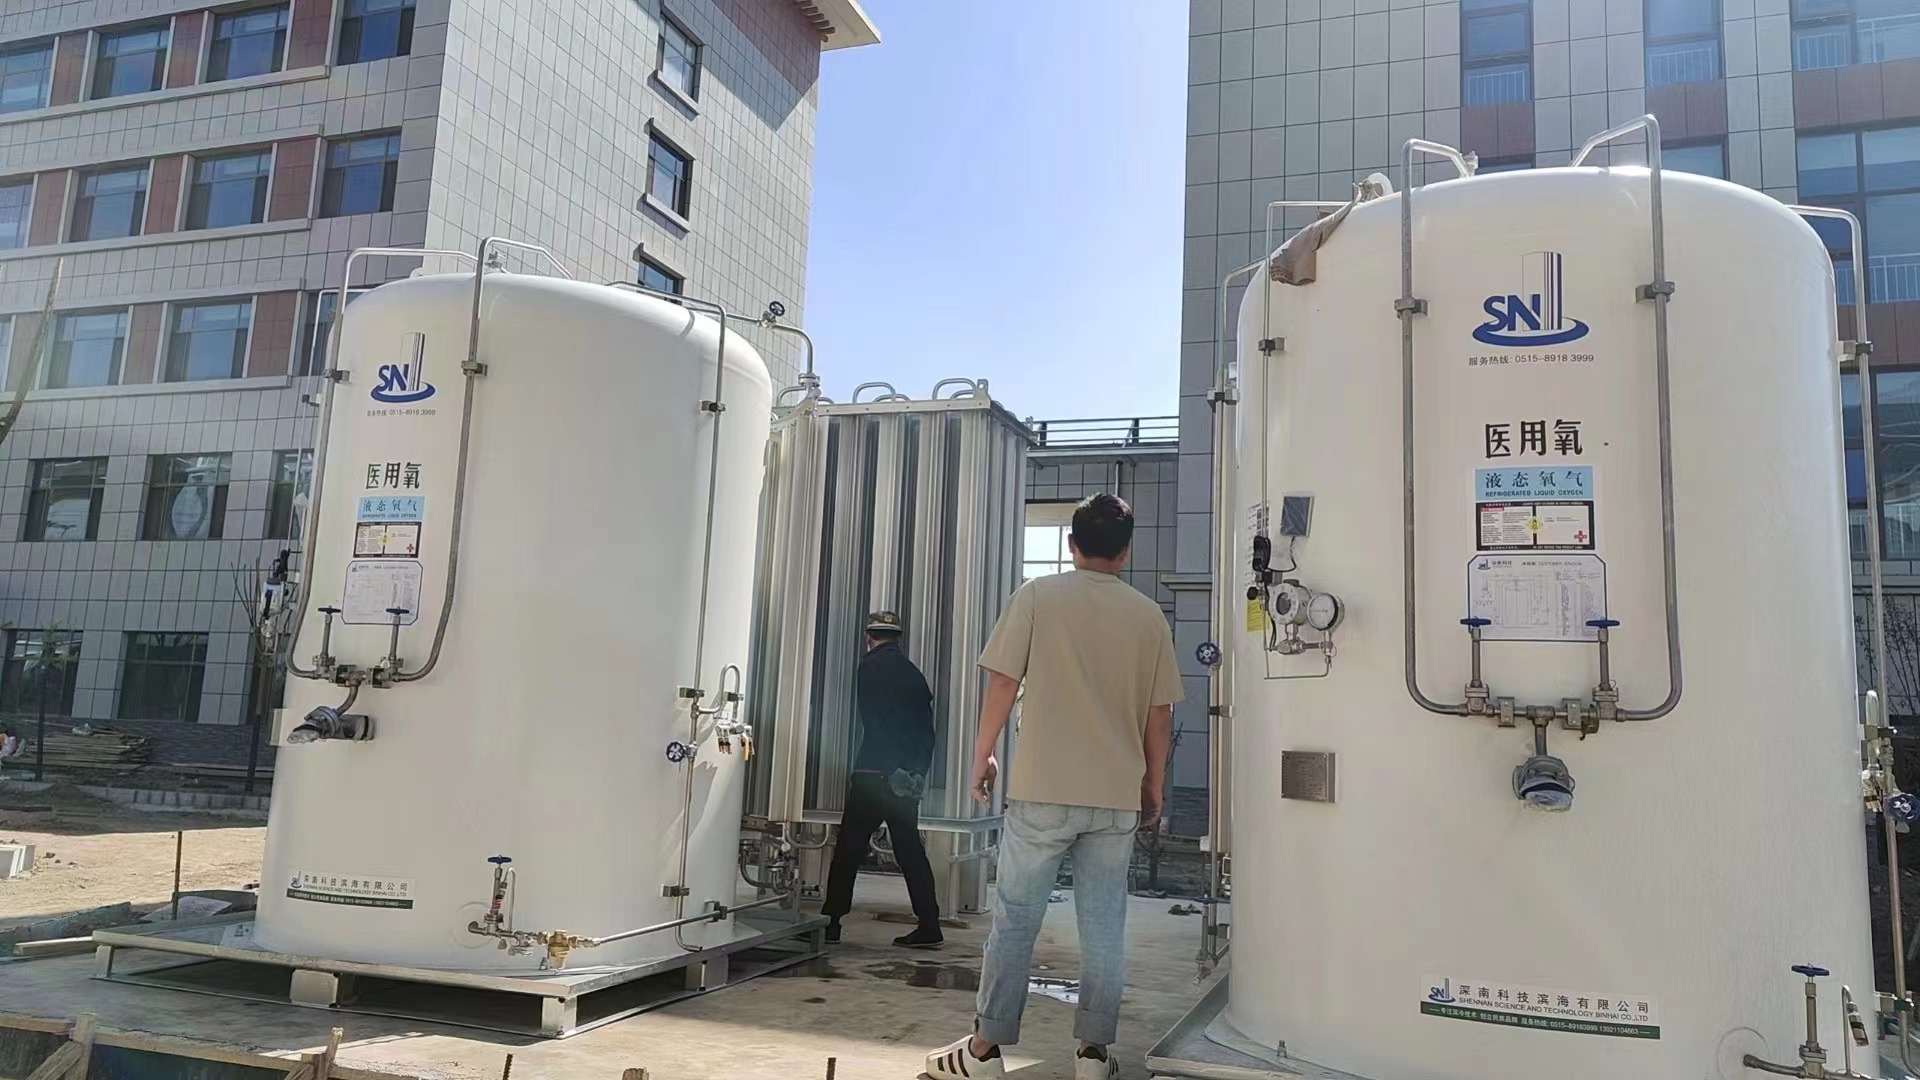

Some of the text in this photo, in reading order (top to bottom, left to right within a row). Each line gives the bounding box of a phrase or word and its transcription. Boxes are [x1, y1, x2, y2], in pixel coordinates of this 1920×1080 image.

[1469, 353, 1594, 367] 服务热线: 0515-8918 3999
[1485, 419, 1583, 459] 医用氧
[365, 462, 422, 489] 医用氧
[1485, 470, 1583, 489] 液态氧气
[1459, 984, 1649, 1014] 深南科技滨海有限公司
[1459, 997, 1493, 1007] SHENNAN
[1494, 1001, 1527, 1010] SCIENCE
[1527, 1005, 1542, 1013] AND
[1544, 1006, 1594, 1018] TECHNOLOGY
[1595, 1011, 1619, 1019] BINHAI
